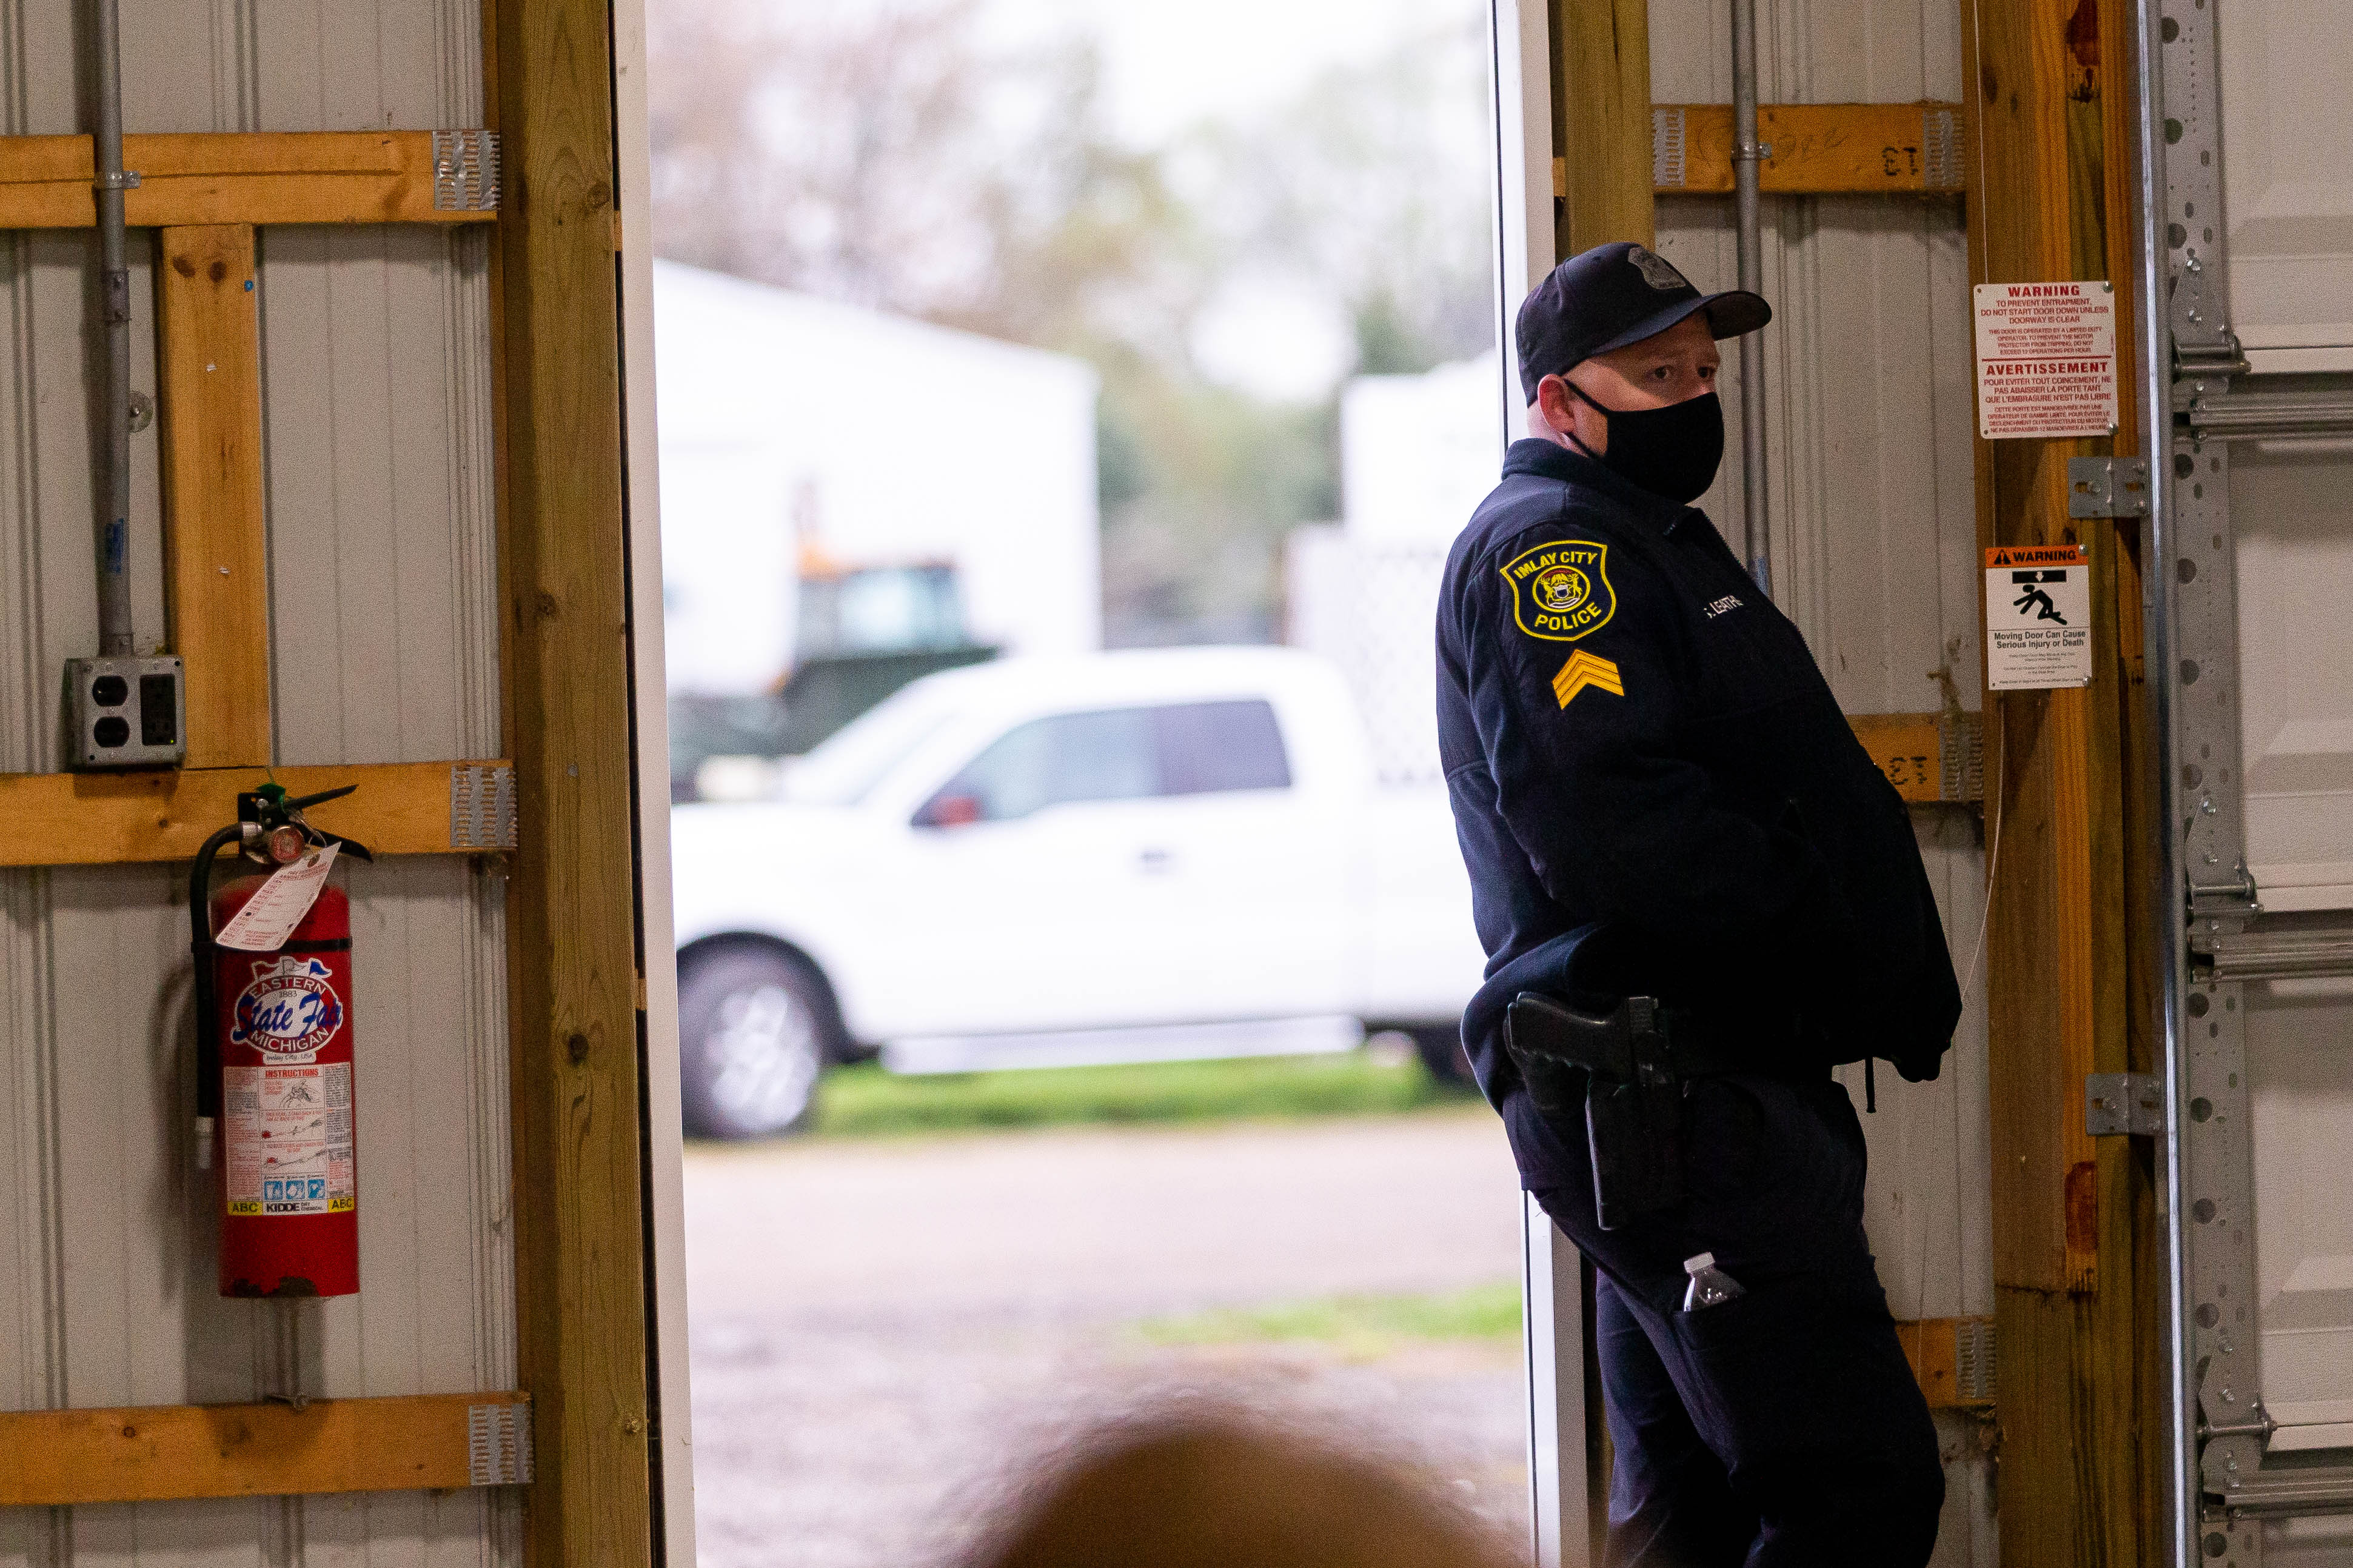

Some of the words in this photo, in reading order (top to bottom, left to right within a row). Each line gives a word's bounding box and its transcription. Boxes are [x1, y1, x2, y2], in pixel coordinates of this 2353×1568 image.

[2009, 285, 2080, 297] WARNING
[1986, 362, 2107, 375] AVERTISSEMENT
[2013, 550, 2077, 562] WARNING
[1514, 554, 1558, 579] IMLAY
[1561, 552, 1598, 565] CITY
[1535, 602, 1602, 630] POLICE
[1995, 632, 2023, 641] Moving
[2029, 640, 2050, 649] Injury
[249, 976, 327, 998] EASTERN
[232, 996, 293, 1041] State
[250, 1029, 329, 1052] MICHIGAN
[266, 1069, 318, 1078] INSTRUCTIONS
[232, 1202, 258, 1212] ABC
[267, 1203, 300, 1212] KIDDE
[332, 1198, 352, 1210] ABC
